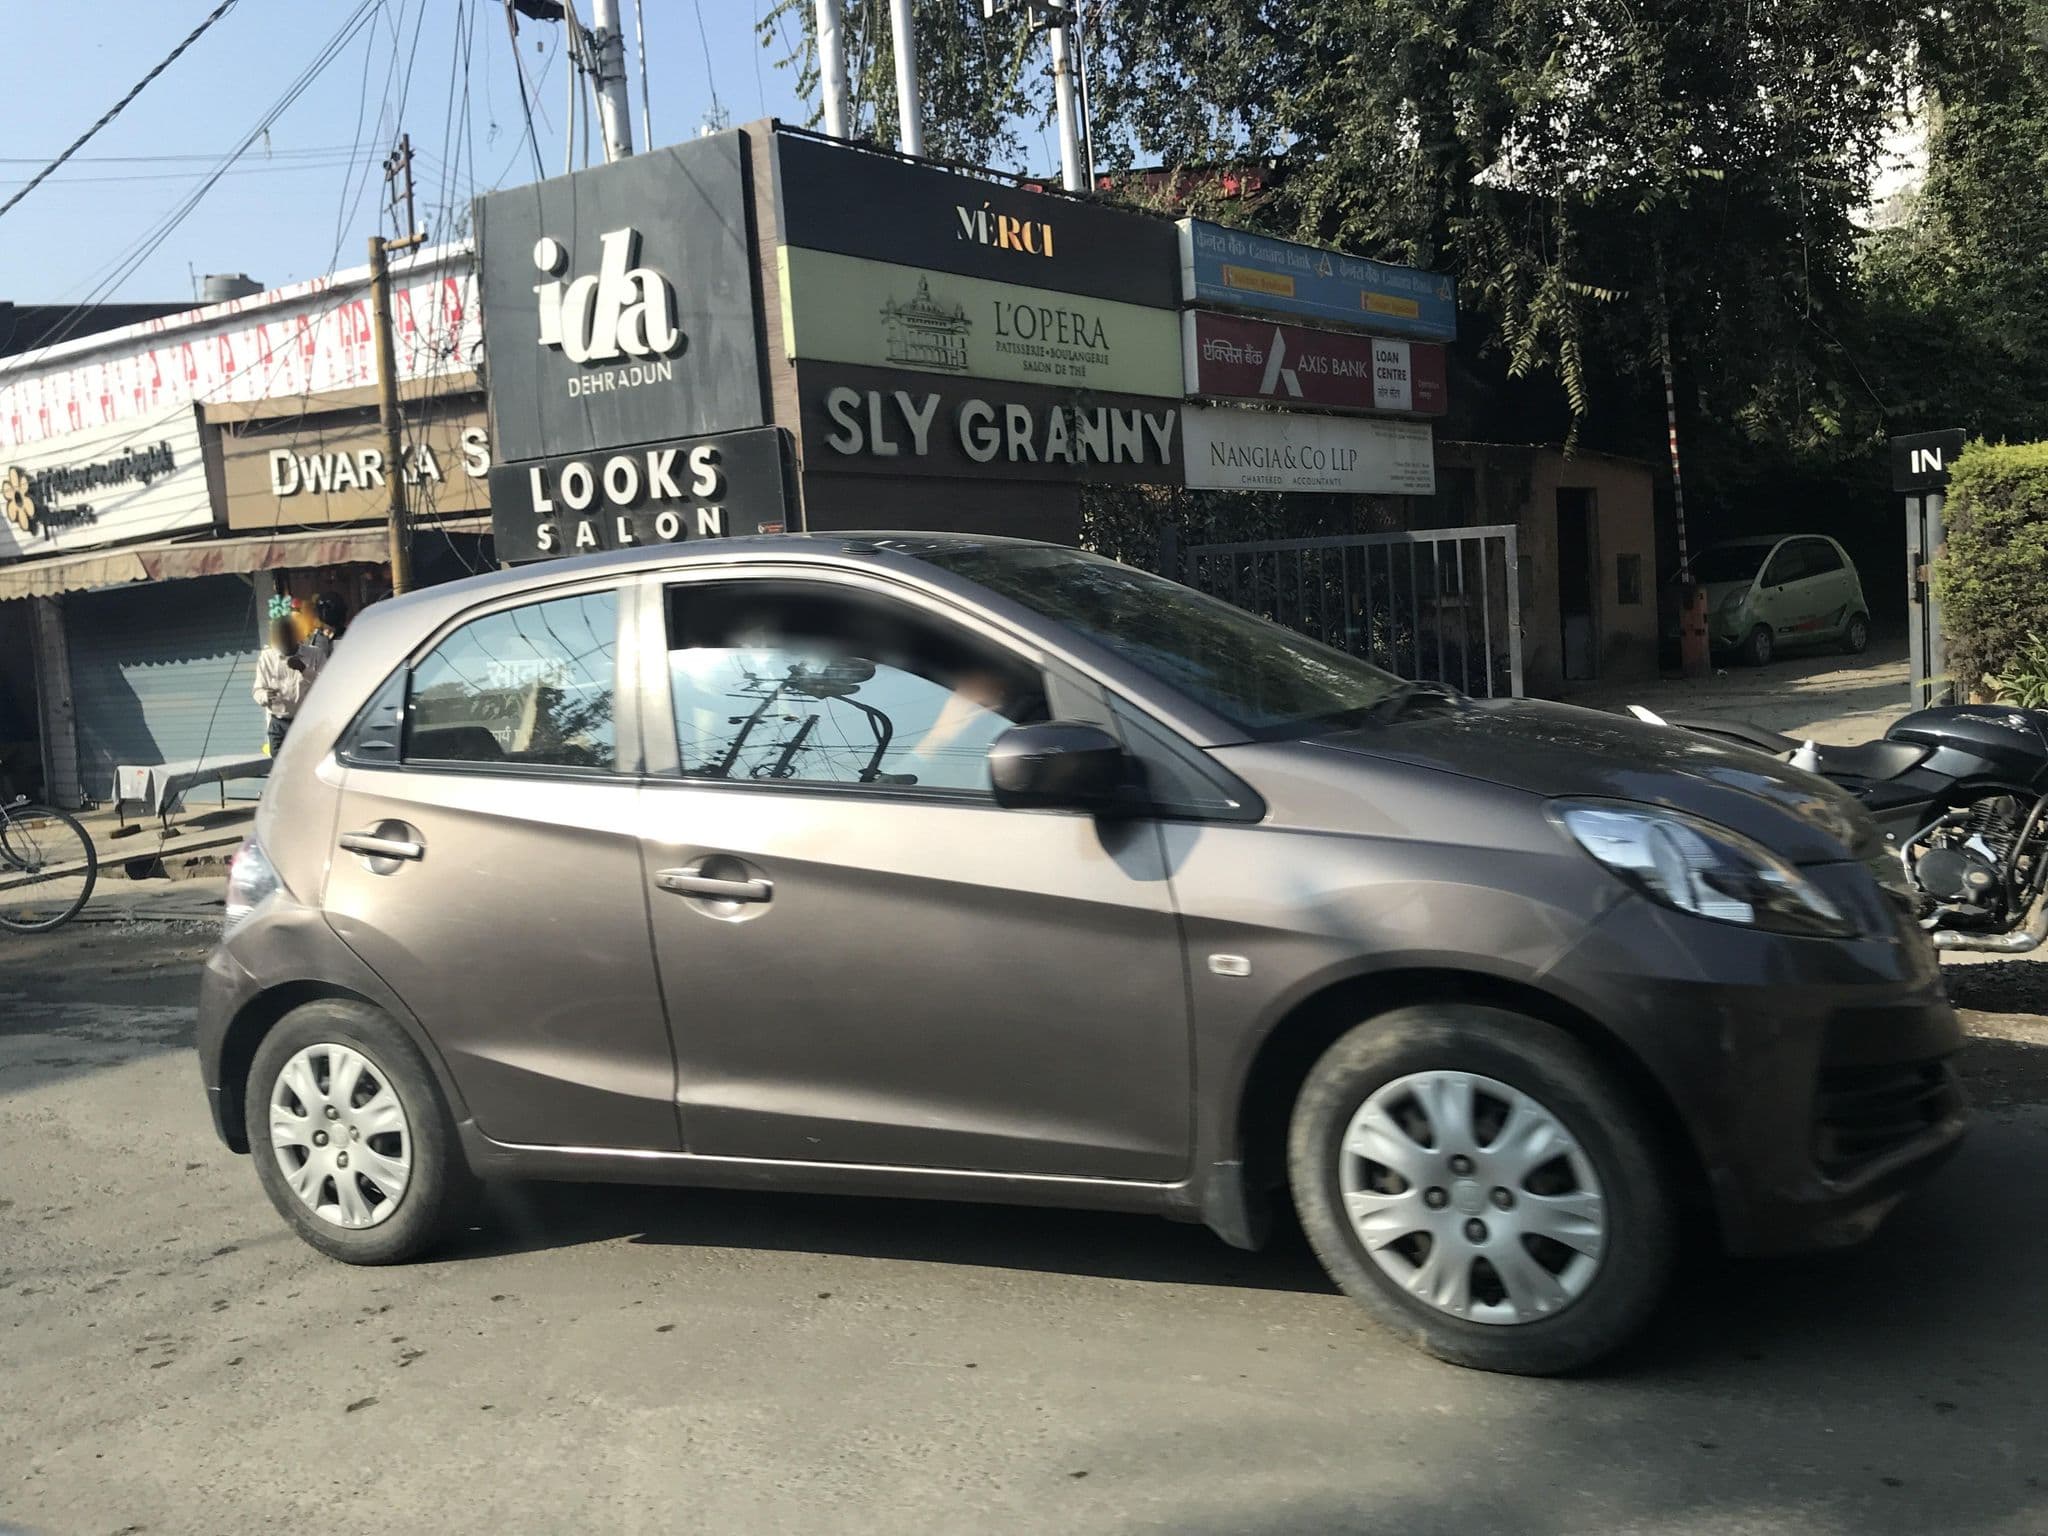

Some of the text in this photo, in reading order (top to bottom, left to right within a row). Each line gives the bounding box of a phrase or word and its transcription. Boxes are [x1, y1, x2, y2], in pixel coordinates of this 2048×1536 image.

[1286, 249, 1312, 271] Bank
[533, 226, 680, 364] ida
[1023, 360, 1052, 374] SALON
[1298, 353, 1368, 379] AXIS BANK
[1375, 350, 1400, 364] LOAN
[568, 361, 673, 398] DEHRADUN
[1376, 366, 1408, 382] CENTRE
[825, 386, 1177, 465] SLY GRANNY
[461, 427, 490, 477] S
[1331, 447, 1357, 472] LLP
[1911, 447, 1942, 473] IN
[529, 445, 719, 513] LOOKS
[1241, 475, 1342, 487] CHARTERED ACCOUNTANTS
[536, 506, 721, 551] SALON
